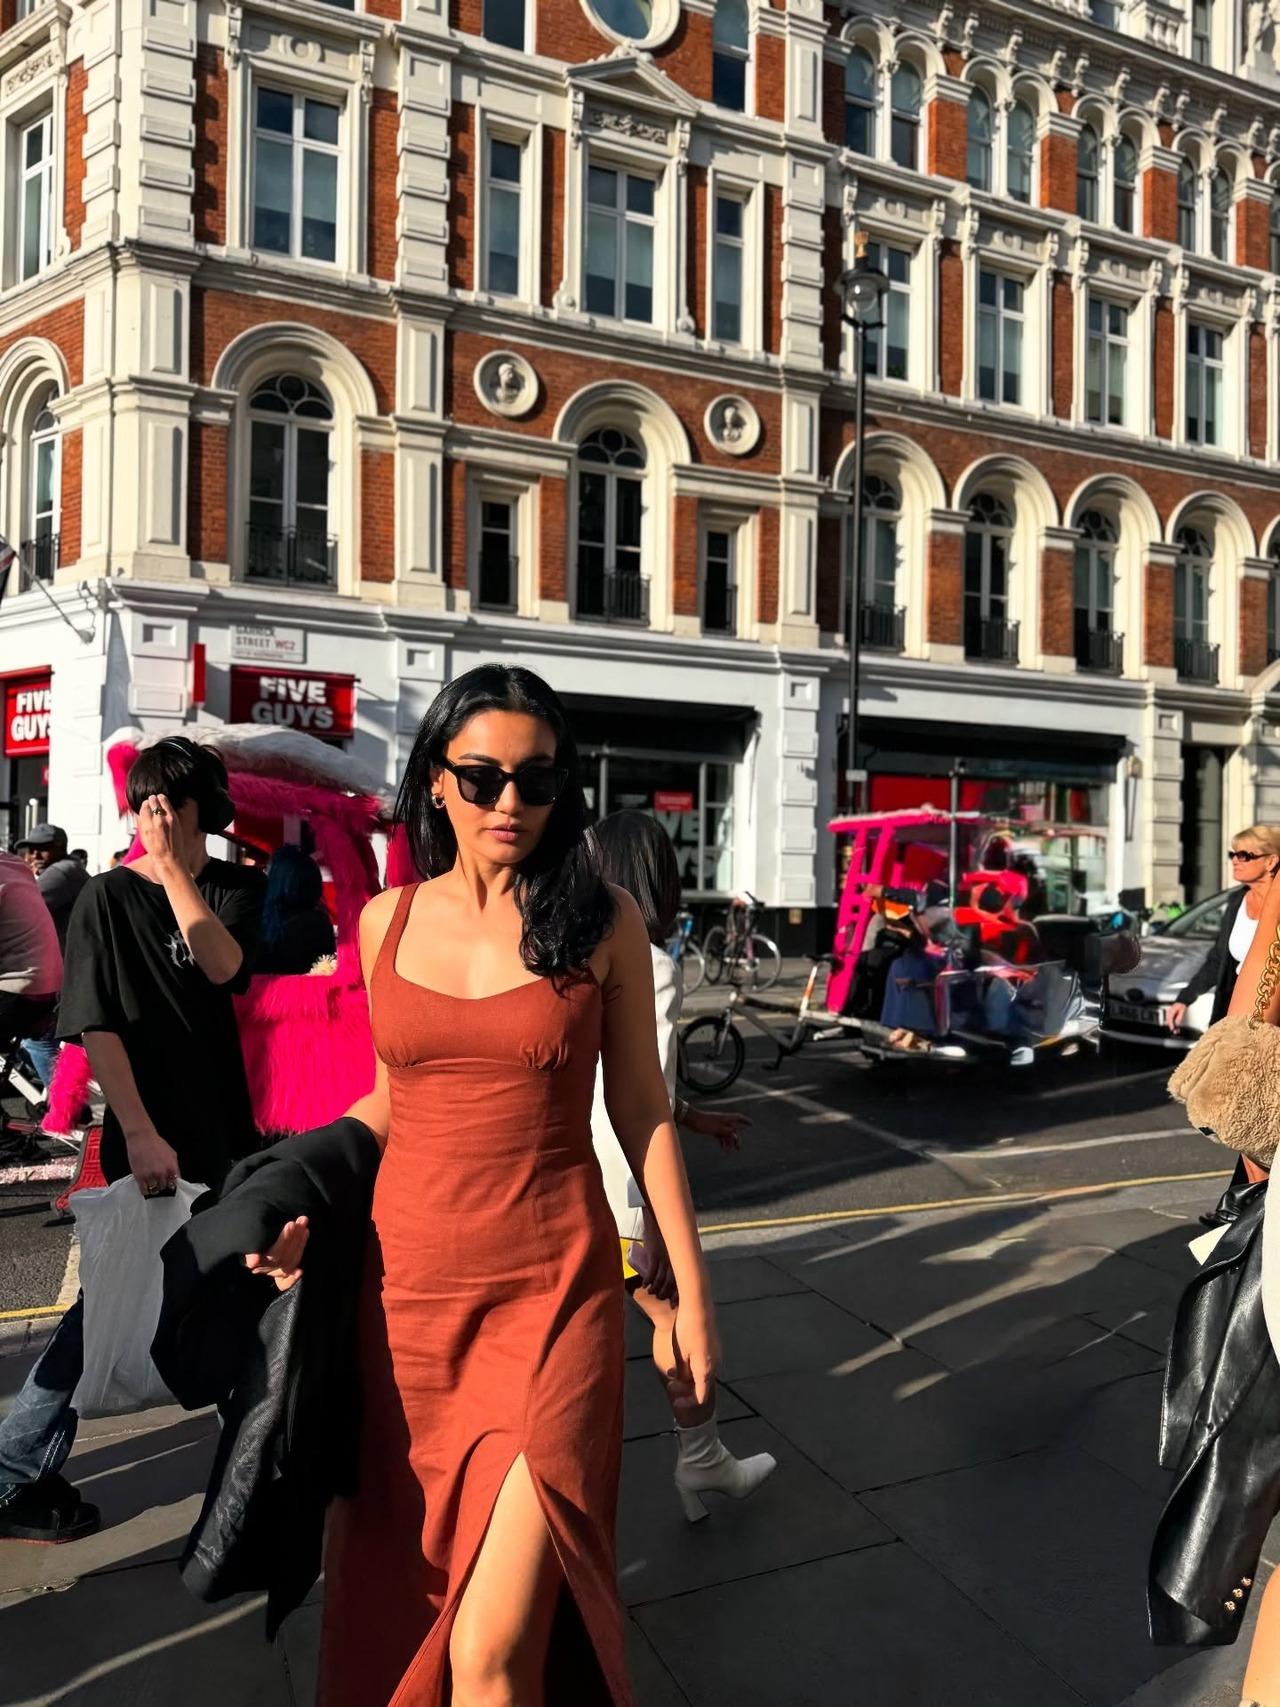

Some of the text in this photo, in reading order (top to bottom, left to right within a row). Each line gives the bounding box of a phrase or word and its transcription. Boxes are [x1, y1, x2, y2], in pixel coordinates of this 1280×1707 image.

[236, 636, 296, 651] STREET WC2
[260, 676, 327, 704] FIVE
[251, 701, 334, 729] GUYS
